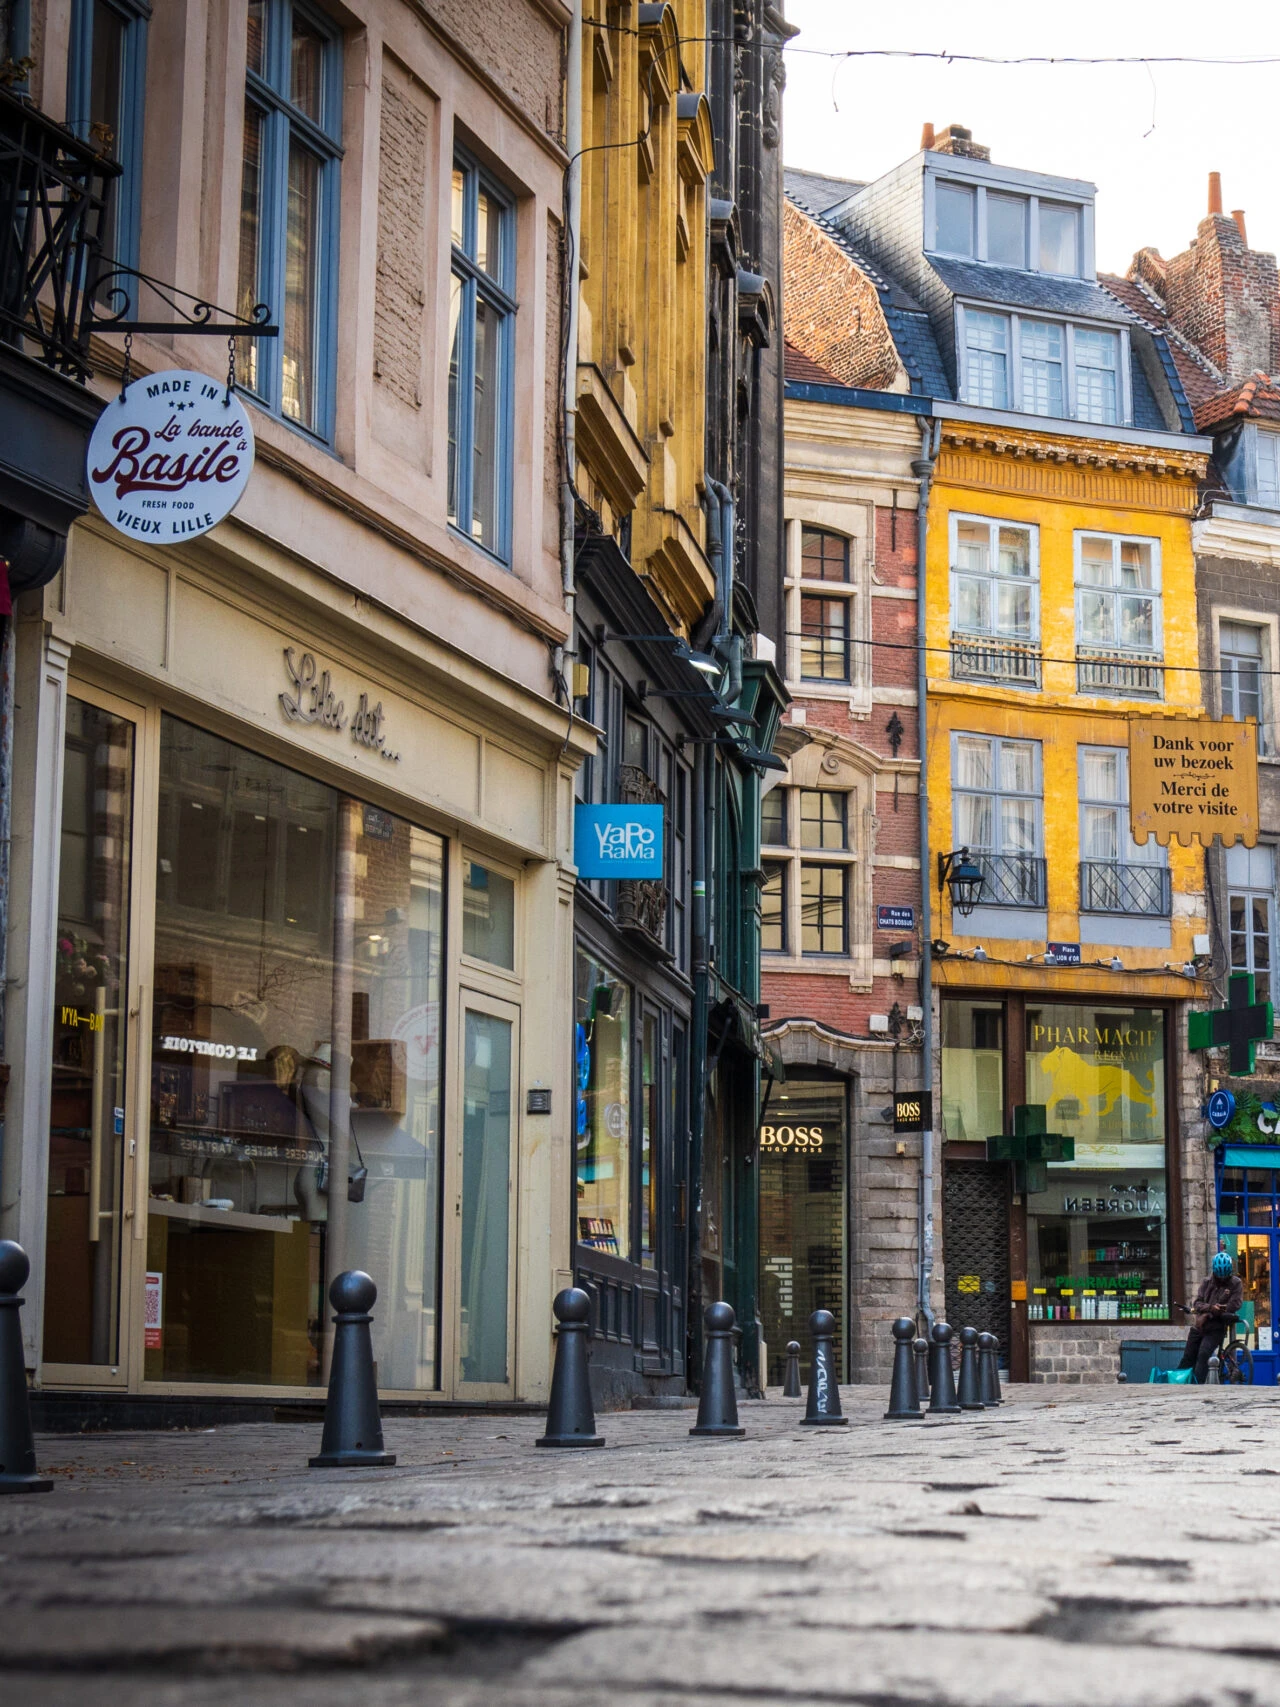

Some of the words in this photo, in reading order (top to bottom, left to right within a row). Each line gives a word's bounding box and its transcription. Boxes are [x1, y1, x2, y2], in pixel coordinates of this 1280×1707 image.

[146, 380, 191, 399] MADE
[200, 384, 218, 400] IN
[154, 414, 182, 442] La
[187, 418, 244, 439] bande
[236, 438, 248, 451] à
[91, 426, 241, 500] Basile
[141, 500, 167, 509] FRESH
[172, 501, 195, 510] FOOD
[116, 509, 162, 534] VIEUX
[172, 513, 214, 534] LILLE
[1152, 735, 1194, 751] Dank
[1198, 740, 1235, 752] voor
[1153, 757, 1176, 768] uw
[1181, 755, 1235, 770] bezoek
[1160, 780, 1207, 797] Merci
[1211, 783, 1230, 798] de
[1153, 802, 1194, 815] votre
[1198, 801, 1238, 816] visite
[599, 843, 655, 859] RaMa
[1062, 945, 1075, 953] Place
[1034, 1024, 1158, 1047] PHARMACIE
[896, 1101, 921, 1118] BOSS
[760, 1125, 824, 1147] BOSS
[1055, 1275, 1143, 1289] PHARMACIE
